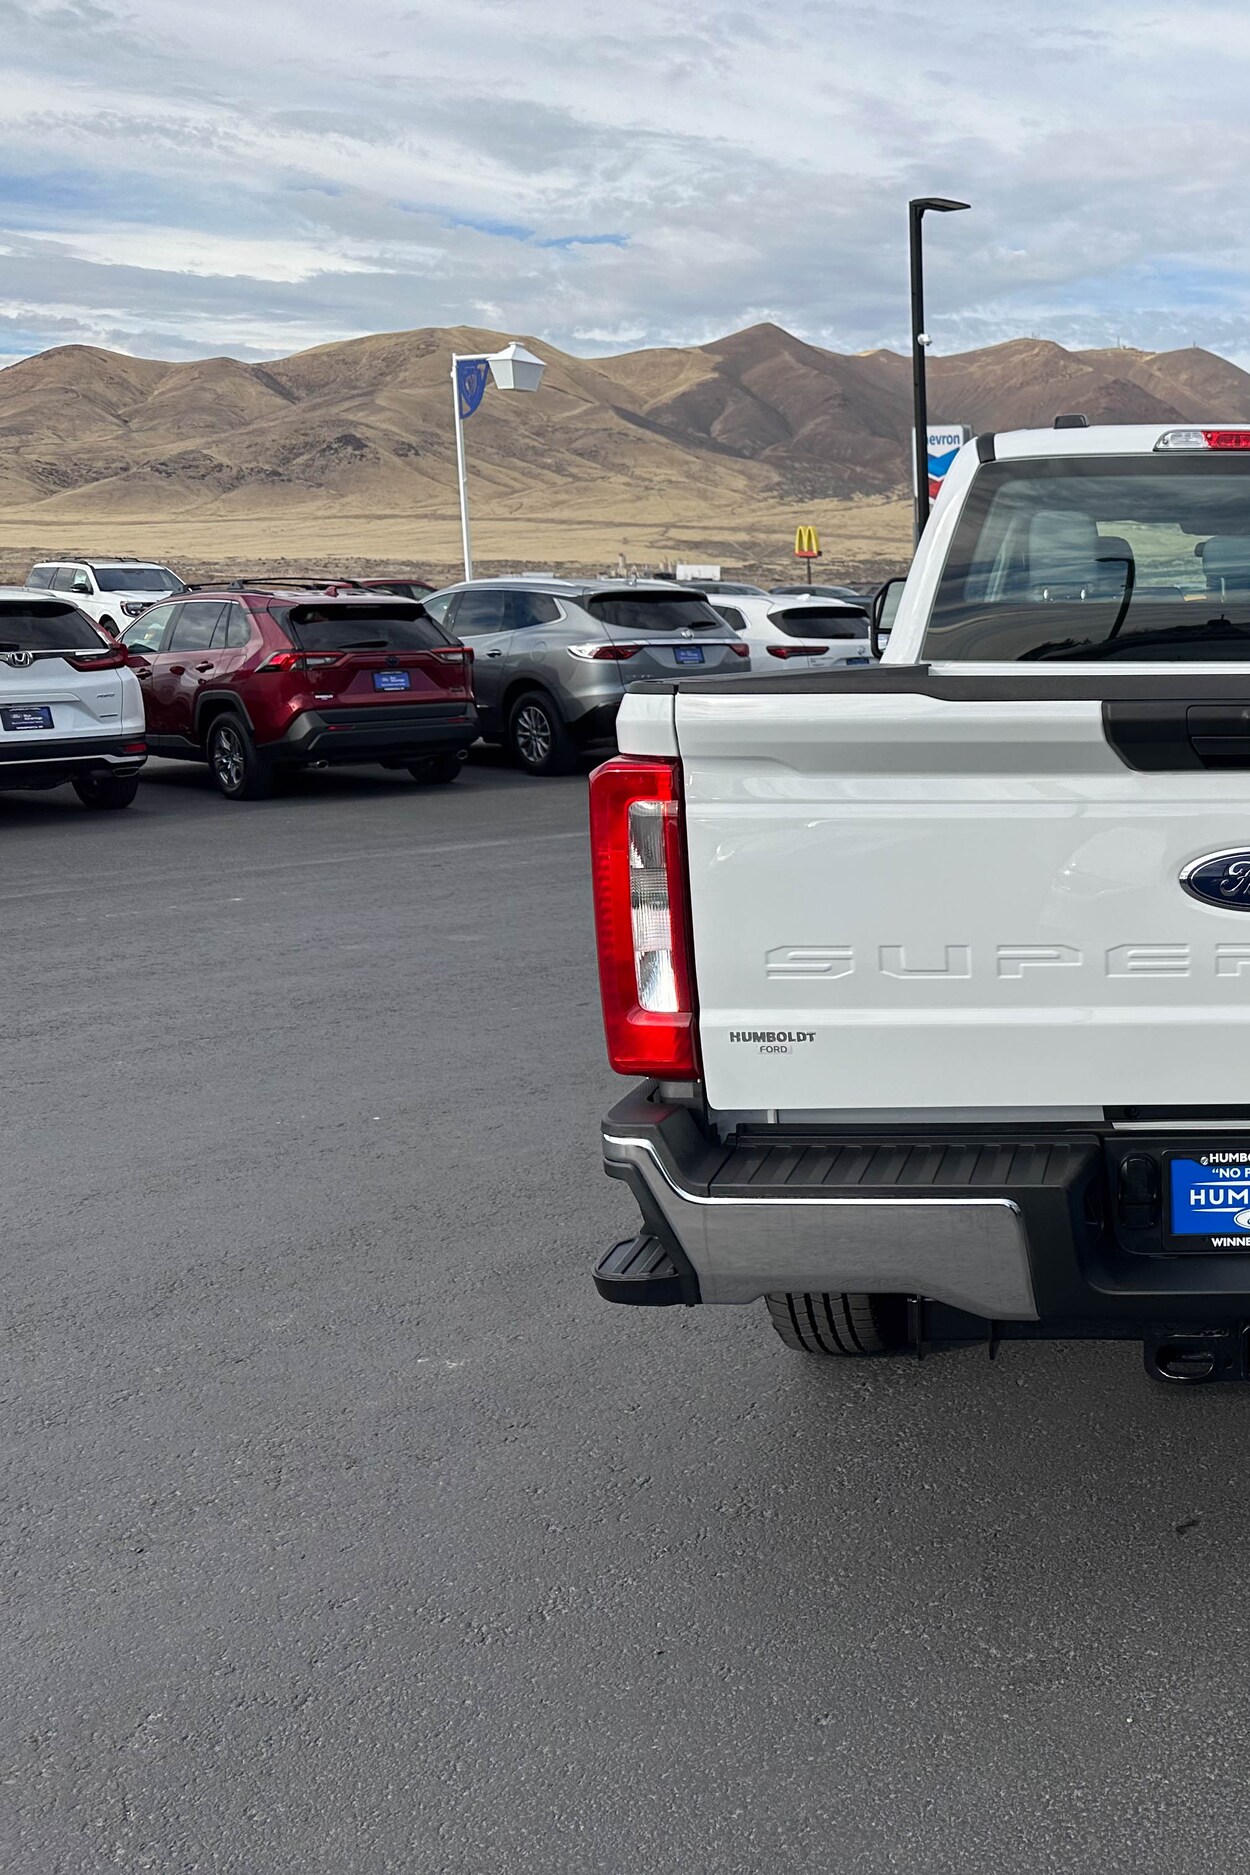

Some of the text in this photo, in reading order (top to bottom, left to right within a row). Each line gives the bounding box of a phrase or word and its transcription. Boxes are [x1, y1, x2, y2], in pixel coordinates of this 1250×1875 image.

[927, 434, 960, 445] evron
[729, 1031, 816, 1043] HUMBOLDT
[759, 1045, 788, 1054] FORD
